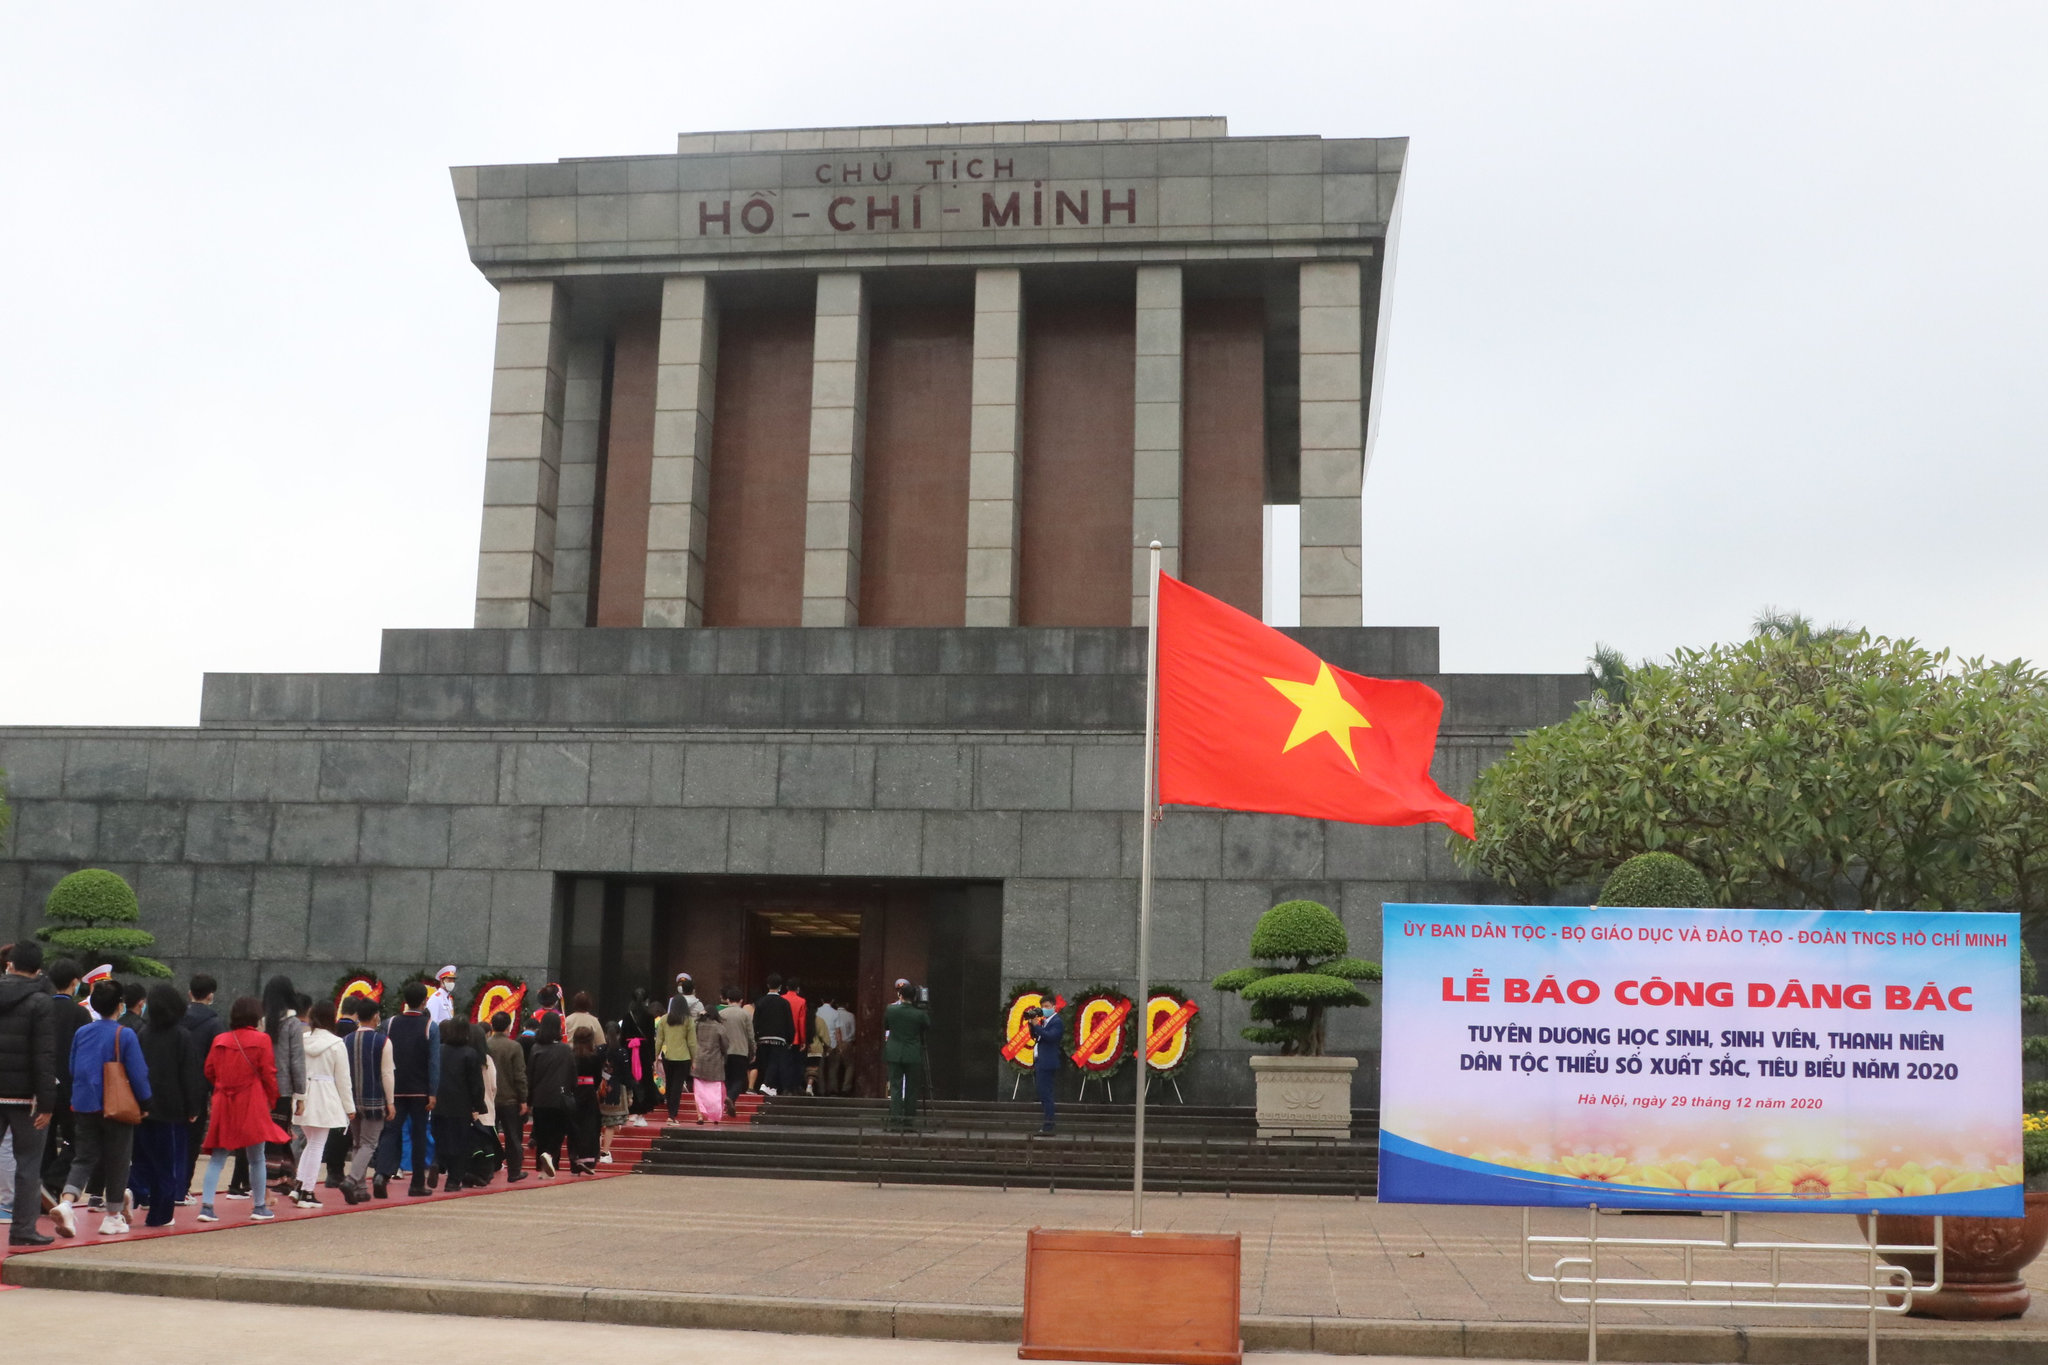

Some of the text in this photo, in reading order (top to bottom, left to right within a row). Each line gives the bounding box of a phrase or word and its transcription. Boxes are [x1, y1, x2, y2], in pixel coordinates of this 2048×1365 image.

[815, 151, 1013, 189] CHỦ TỊCH
[699, 189, 777, 236] HỒ
[828, 184, 927, 232] CHÍ
[1403, 919, 1427, 937] ỦY
[1431, 923, 1466, 938] BAN
[1471, 921, 1507, 939] DÂN
[1511, 924, 1547, 942] TỘC
[1591, 924, 1633, 941] GIÁO
[1638, 928, 1673, 944] DỤC
[1679, 926, 1701, 942] VÀ
[1706, 926, 1743, 943] ĐÀO
[1748, 930, 1783, 947] TẠO
[1798, 928, 1847, 945] ĐOÀN
[1852, 931, 1897, 946] TNCS
[1932, 930, 1960, 947] CHÍ
[1965, 933, 2007, 947] MINH
[1442, 968, 1973, 1012] LỄ BÁO CÔNG DÂNG BÁC
[1468, 1022, 1944, 1051] TUYÊN DƯƠNG HỌC SINH, SINH VIÊN, THANH NIÊN
[1460, 1049, 1959, 1081] DÂN TỘC THIỂU SỐ XUẤT SẮC, TIÊU BIỂU NĂM 2020
[1577, 1093, 1824, 1111] Hà Nội, ngày 29 tháng 12 năm 2020
